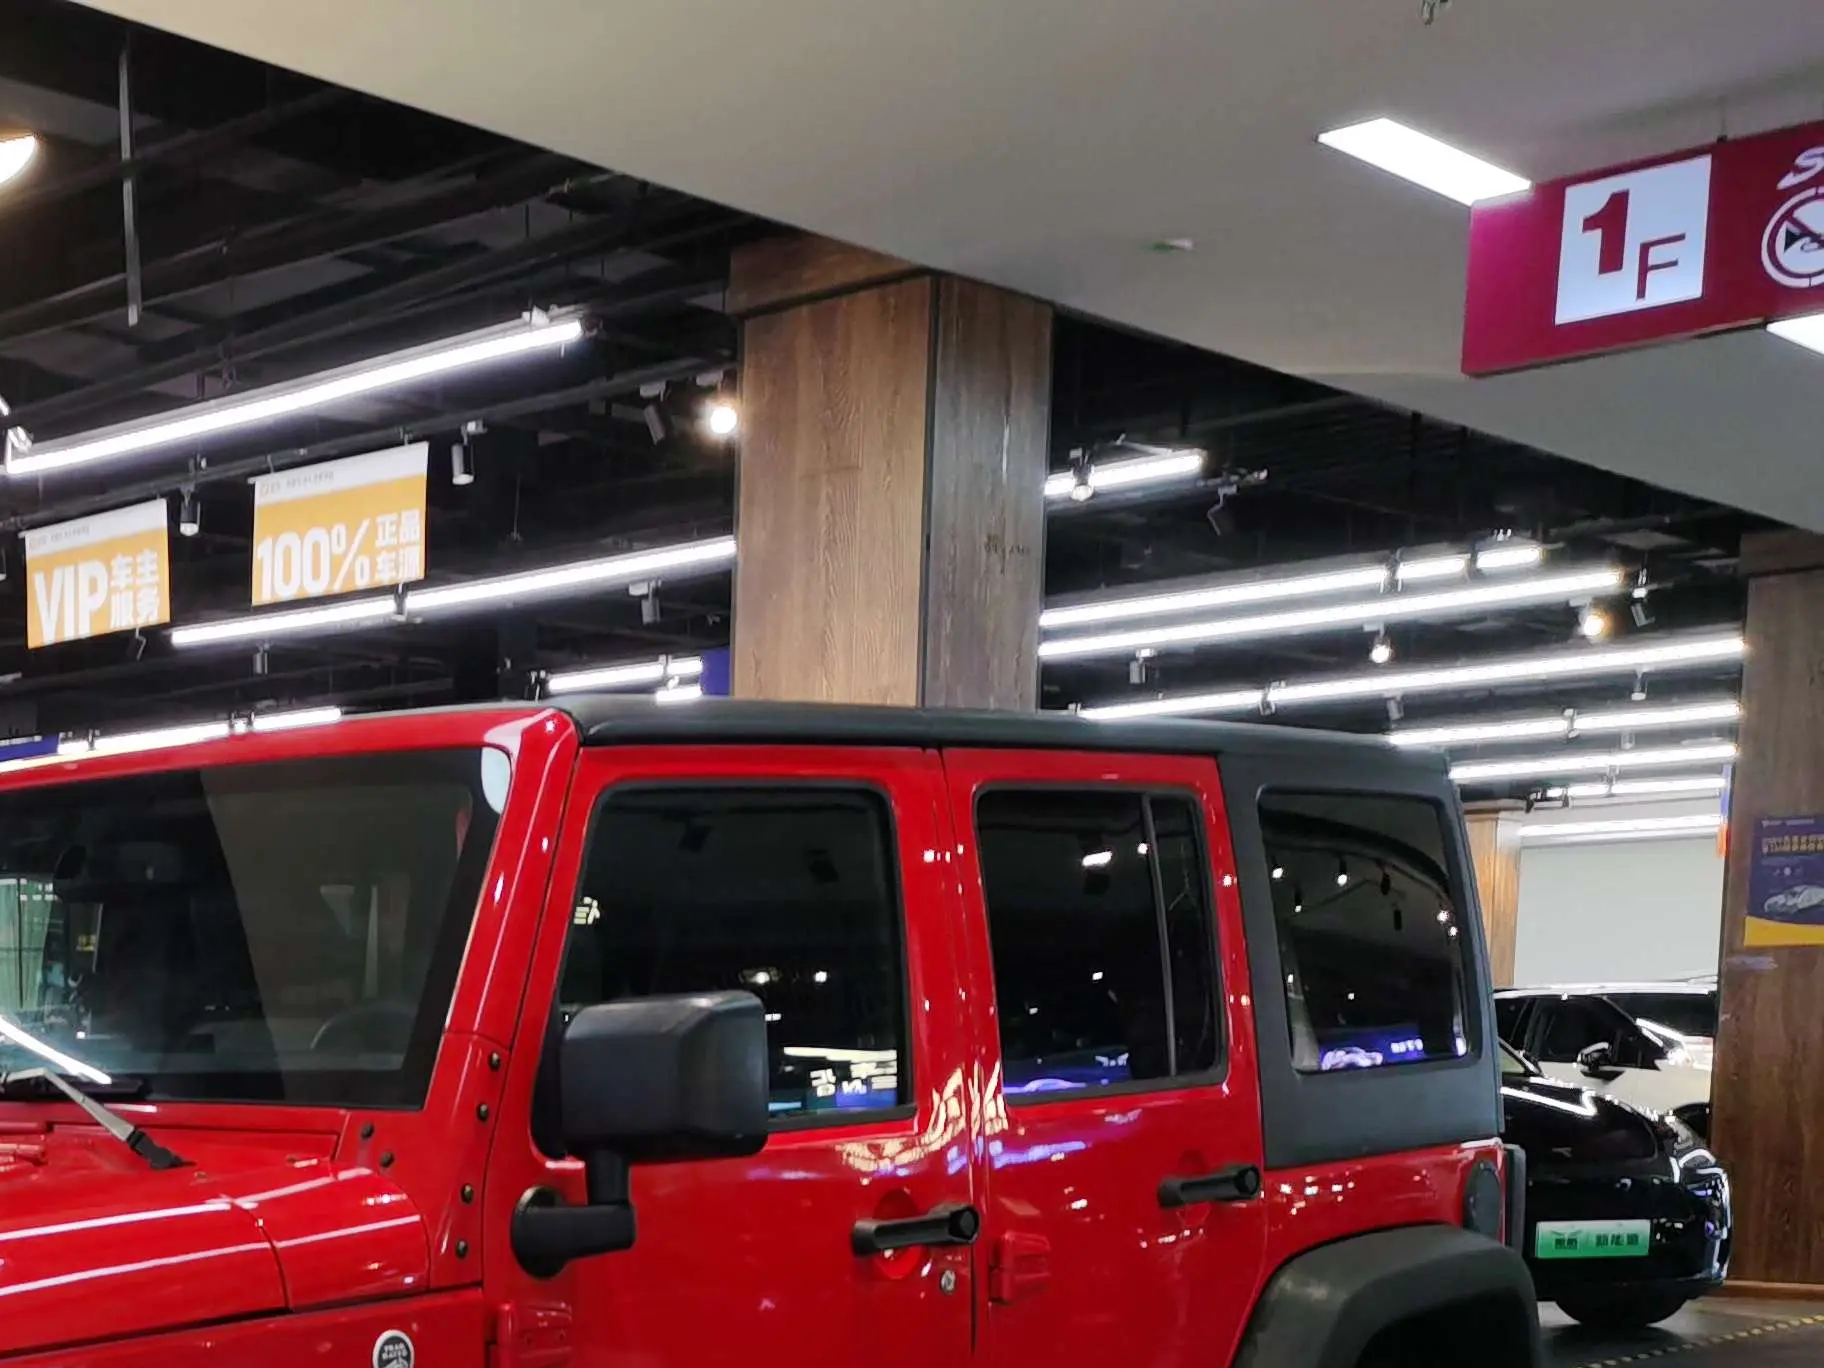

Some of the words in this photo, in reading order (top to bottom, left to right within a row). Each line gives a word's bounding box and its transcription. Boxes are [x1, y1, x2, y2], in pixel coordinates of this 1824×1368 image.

[257, 518, 371, 601] 100%
[375, 509, 421, 548] 正品
[375, 545, 421, 584] 车源
[34, 559, 109, 645] VIP
[110, 547, 159, 589] 车主
[111, 586, 161, 629] 服务
